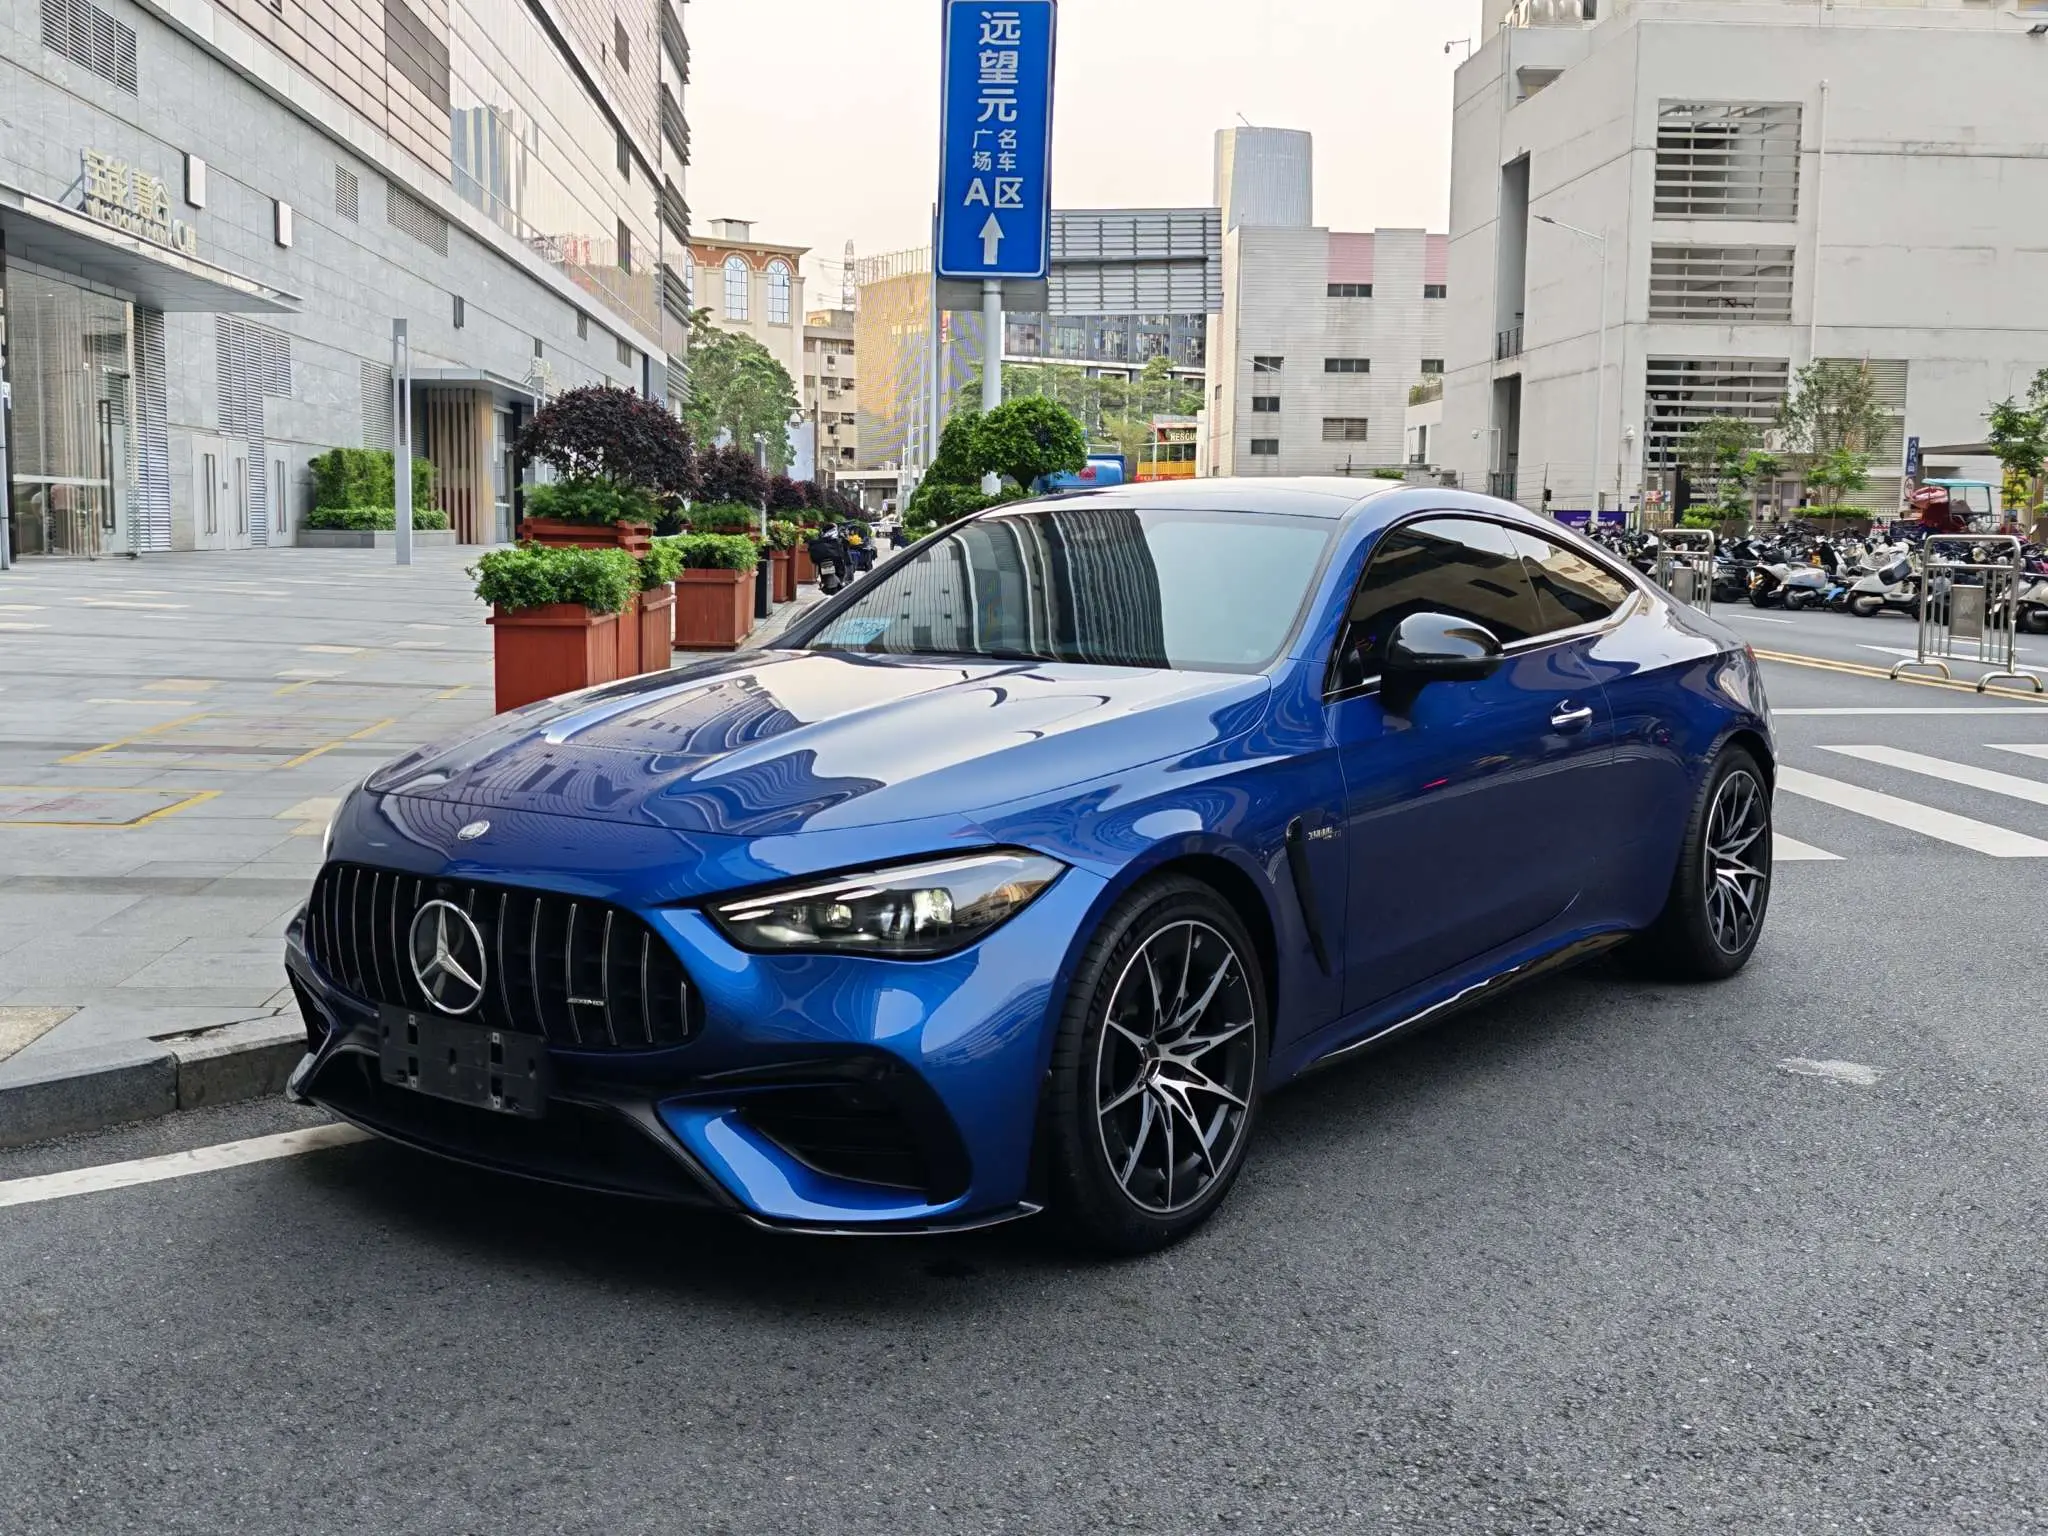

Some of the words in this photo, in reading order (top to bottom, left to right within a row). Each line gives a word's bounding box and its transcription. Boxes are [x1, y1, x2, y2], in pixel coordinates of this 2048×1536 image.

[977, 11, 1020, 122] 远望元
[972, 129, 992, 171] 广场
[997, 129, 1016, 171] 名车
[963, 177, 1023, 208] A区
